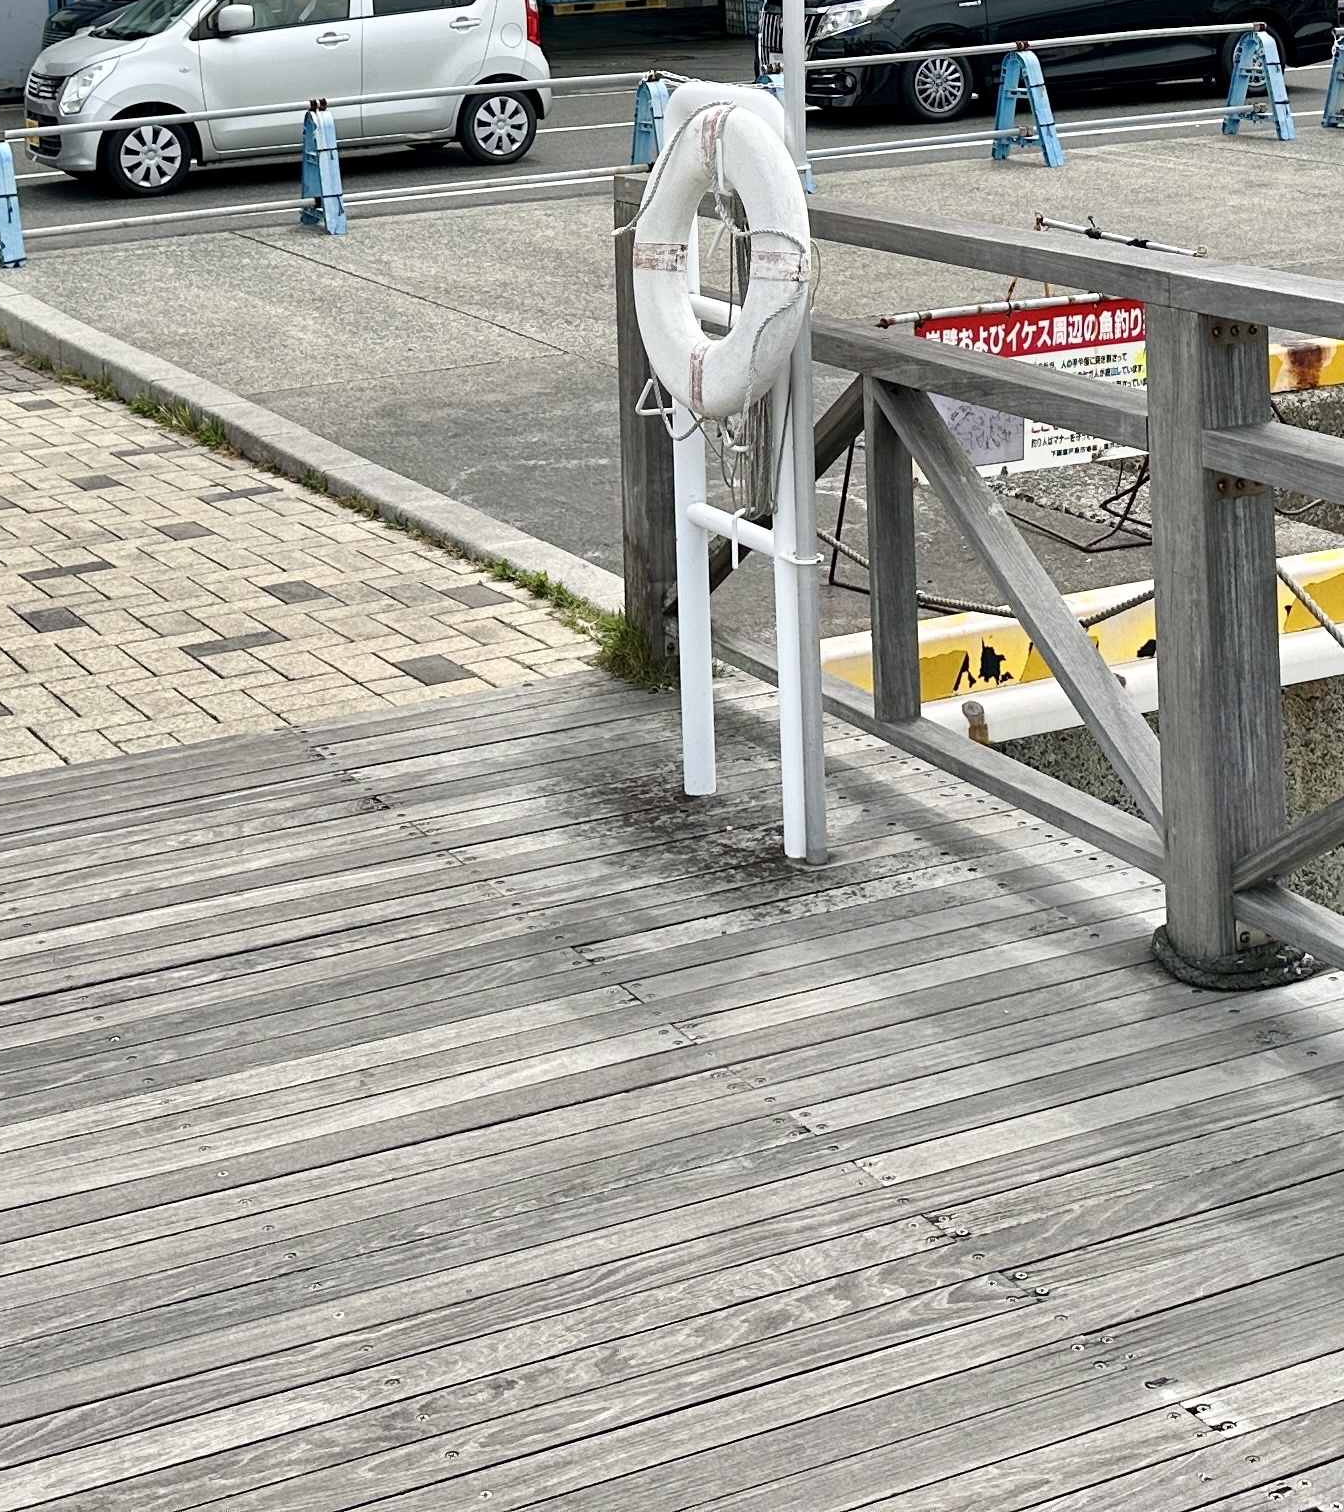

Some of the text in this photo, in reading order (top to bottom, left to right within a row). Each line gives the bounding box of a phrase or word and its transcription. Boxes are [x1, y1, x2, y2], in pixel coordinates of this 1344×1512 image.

[926, 307, 1146, 354] 壁およびイケス周辺の魚釣り
